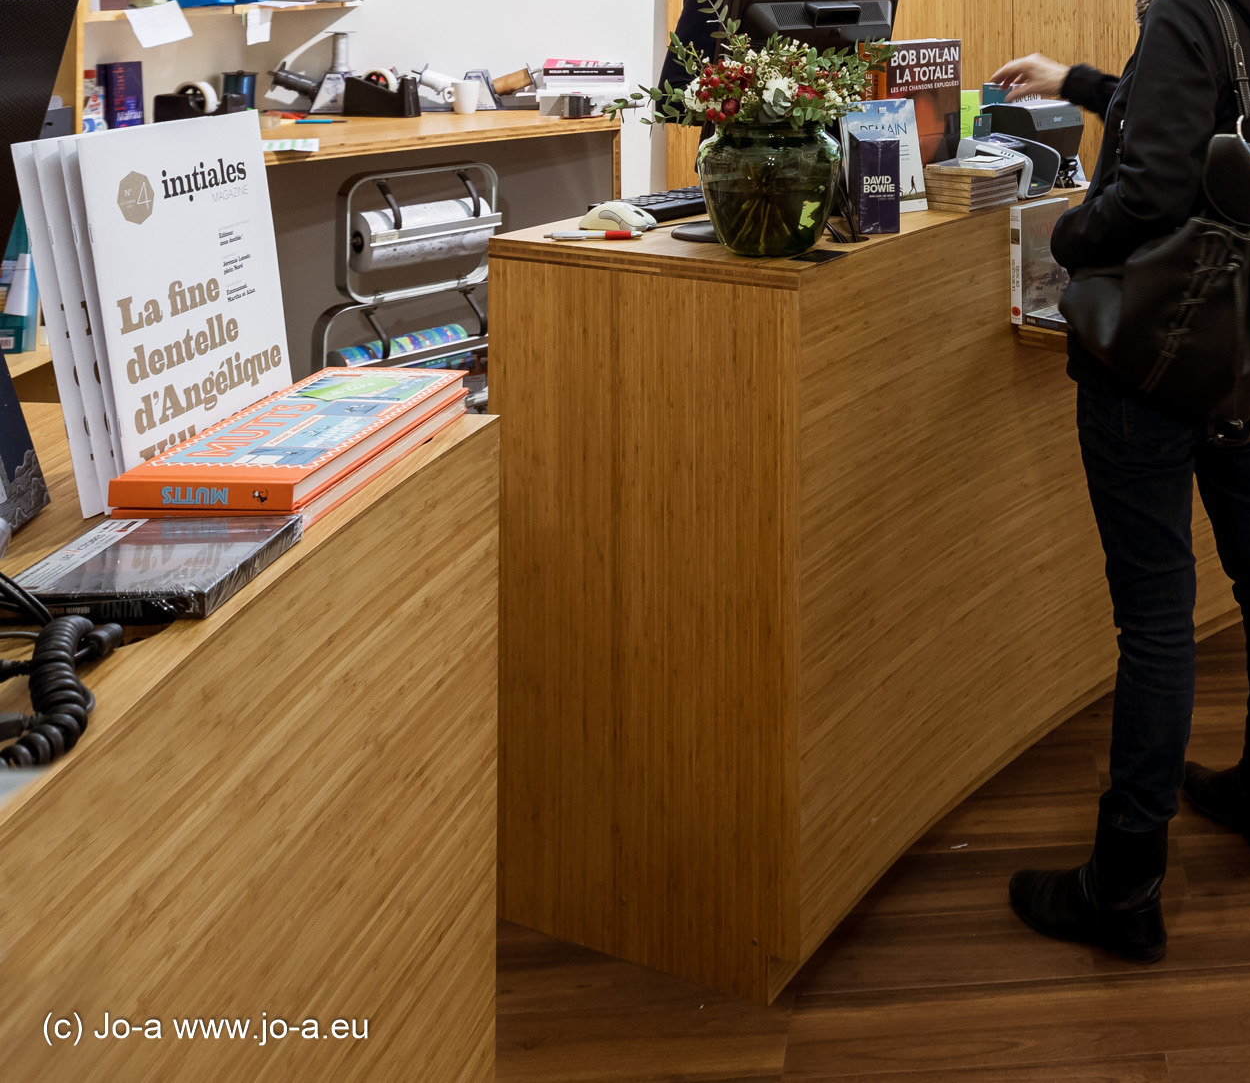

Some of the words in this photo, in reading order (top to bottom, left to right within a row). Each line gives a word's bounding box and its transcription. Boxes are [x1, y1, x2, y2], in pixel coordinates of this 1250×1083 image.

[891, 49, 917, 67] BOB
[920, 46, 959, 64] DYLAN
[896, 68, 911, 84] LA
[913, 65, 954, 82] TOTALE
[908, 83, 933, 91] CHANSONS
[934, 80, 960, 89] EXPLIQUÉES
[863, 175, 892, 184] DAVID
[863, 183, 895, 194] BOWIE
[137, 181, 152, 209] 4
[211, 184, 249, 204] MAGAZINE
[117, 294, 164, 335] La
[167, 276, 220, 317] fine
[126, 312, 239, 385] dentelle
[134, 344, 282, 435] d'Angélique
[185, 402, 318, 458] MUTTS
[161, 485, 228, 506] MUTTS
[101, 600, 143, 618] WIND
